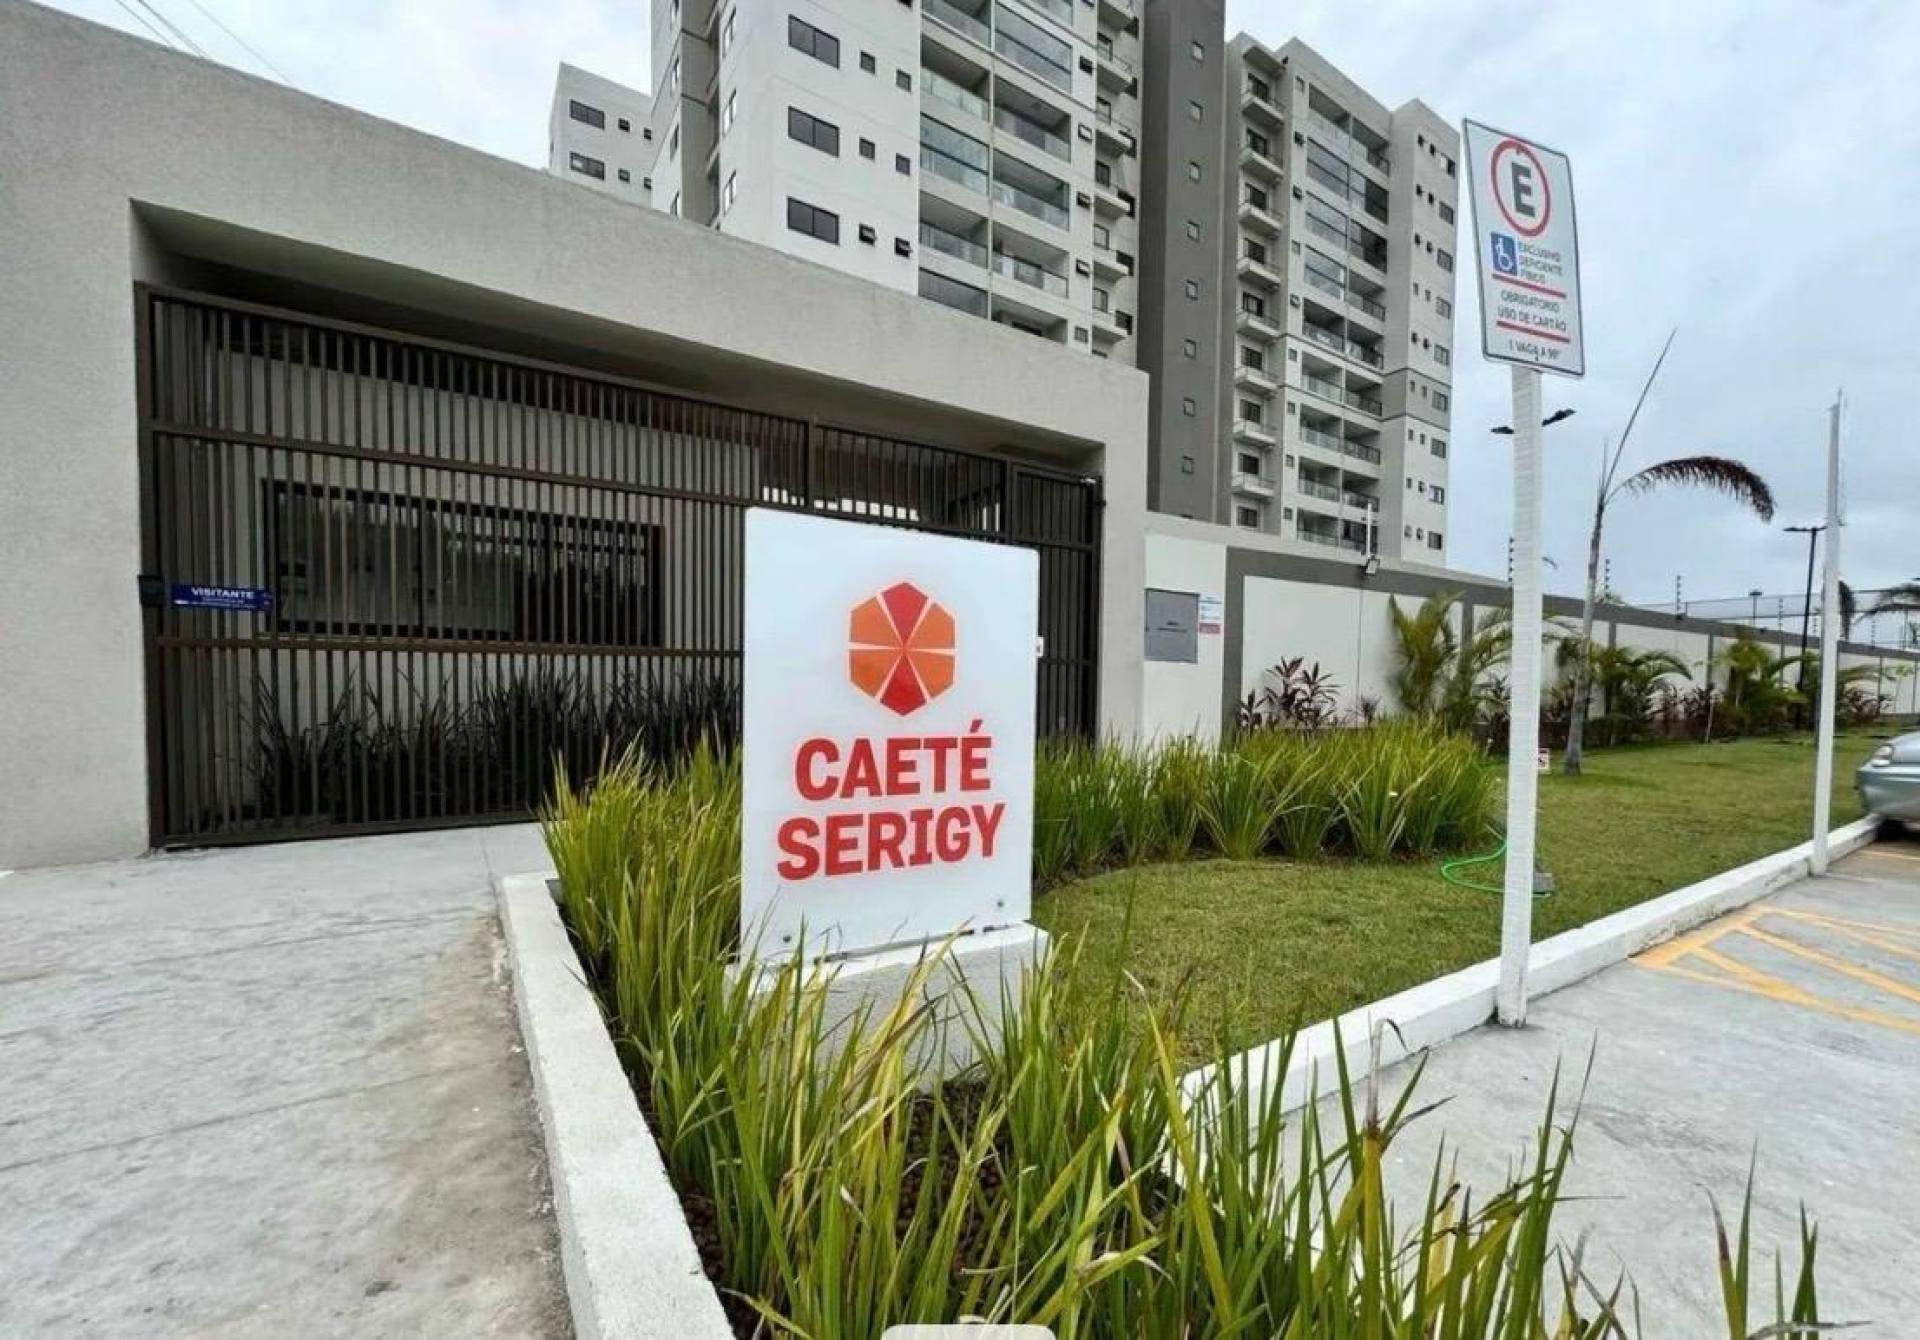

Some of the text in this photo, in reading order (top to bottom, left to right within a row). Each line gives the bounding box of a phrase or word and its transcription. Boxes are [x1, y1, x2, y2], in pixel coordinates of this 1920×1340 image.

[1511, 162, 1535, 217] E
[1498, 305, 1515, 320] USO
[1519, 310, 1530, 324] DE
[191, 587, 254, 599] VISITANTE
[795, 720, 990, 801] CAETÉ
[777, 803, 1006, 881] SERIGY
